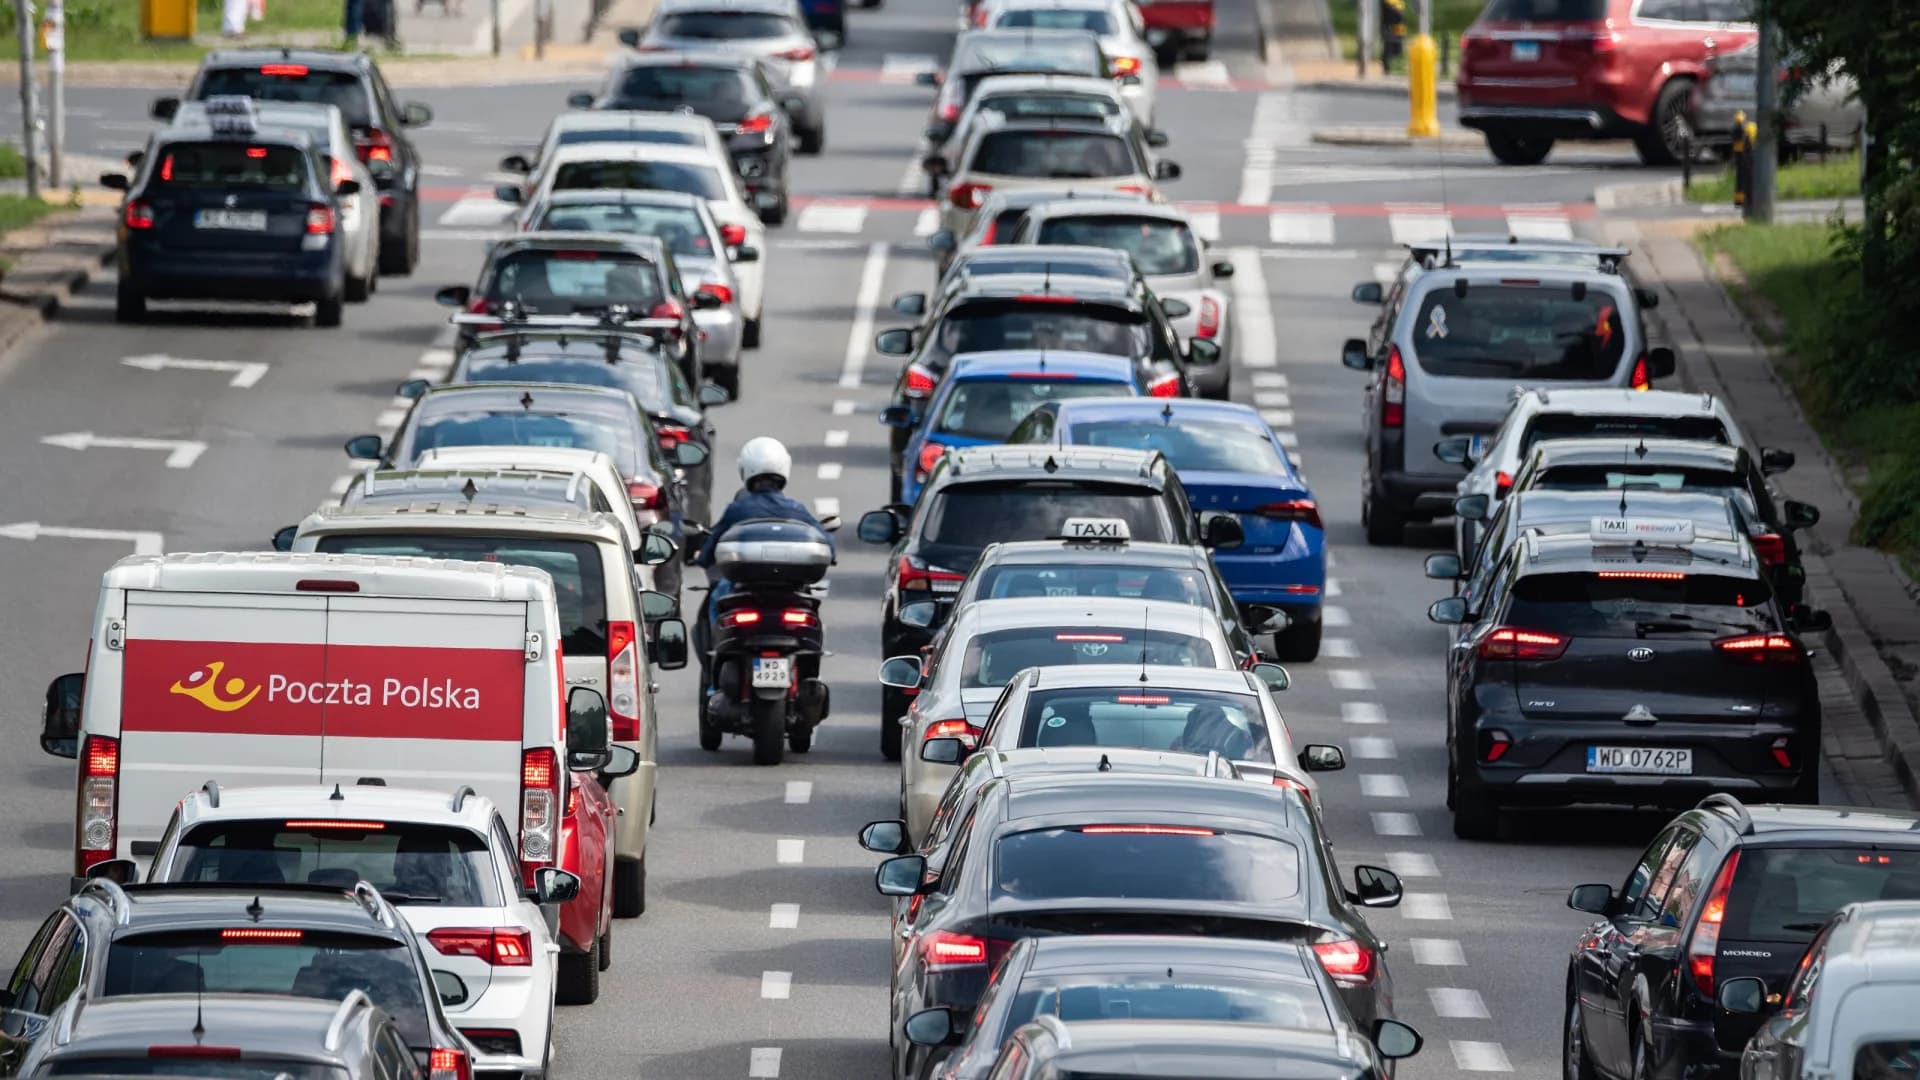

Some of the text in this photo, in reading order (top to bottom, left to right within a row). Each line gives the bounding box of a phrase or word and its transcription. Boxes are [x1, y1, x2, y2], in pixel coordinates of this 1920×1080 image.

[1071, 523, 1117, 536] TAXI
[1603, 521, 1625, 531] TAXI
[764, 661, 779, 670] WD
[267, 674, 480, 709] Poczta Polska
[1599, 749, 1687, 768] WD 0762P
[1722, 950, 1772, 958] MONDEO
